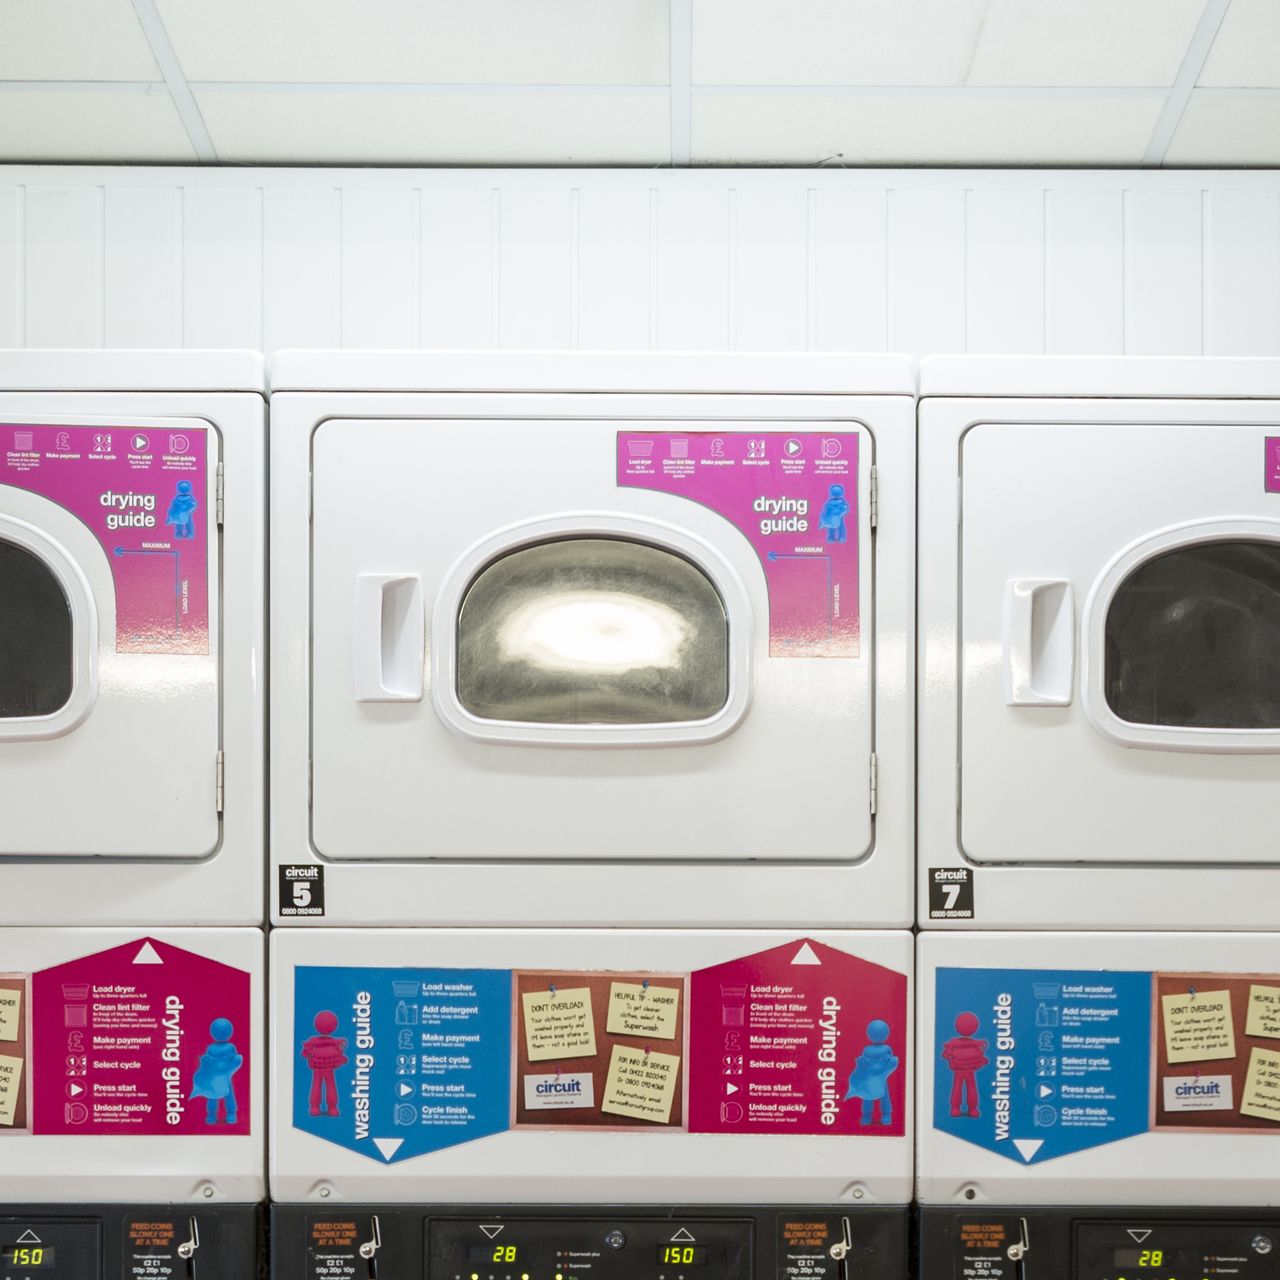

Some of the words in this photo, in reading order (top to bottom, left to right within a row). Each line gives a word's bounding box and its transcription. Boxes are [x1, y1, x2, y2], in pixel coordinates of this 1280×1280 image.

[100, 492, 155, 510] drying
[754, 497, 808, 514] drying
[107, 512, 155, 529] guide
[761, 517, 808, 534] guide
[286, 867, 318, 878] circuit
[934, 870, 968, 880] circuit
[293, 882, 311, 906] 5
[942, 884, 961, 909] 7
[115, 985, 135, 994] dryer
[162, 995, 184, 1061] drying
[355, 991, 374, 1051] guide
[822, 996, 837, 1061] drying
[995, 992, 1014, 1052] guide
[117, 1037, 151, 1045] payment
[120, 1062, 141, 1070] cycle
[536, 1078, 581, 1095] circuit
[1175, 1081, 1220, 1098] circuit
[162, 1067, 184, 1125] guide
[355, 1055, 374, 1140] washing
[820, 1067, 837, 1126] guide
[995, 1057, 1013, 1141] washing
[124, 1105, 152, 1113] quickly
[13, 1249, 43, 1265] 150
[492, 1247, 516, 1263] 28
[664, 1248, 694, 1263] 150
[1138, 1251, 1163, 1266] 28
